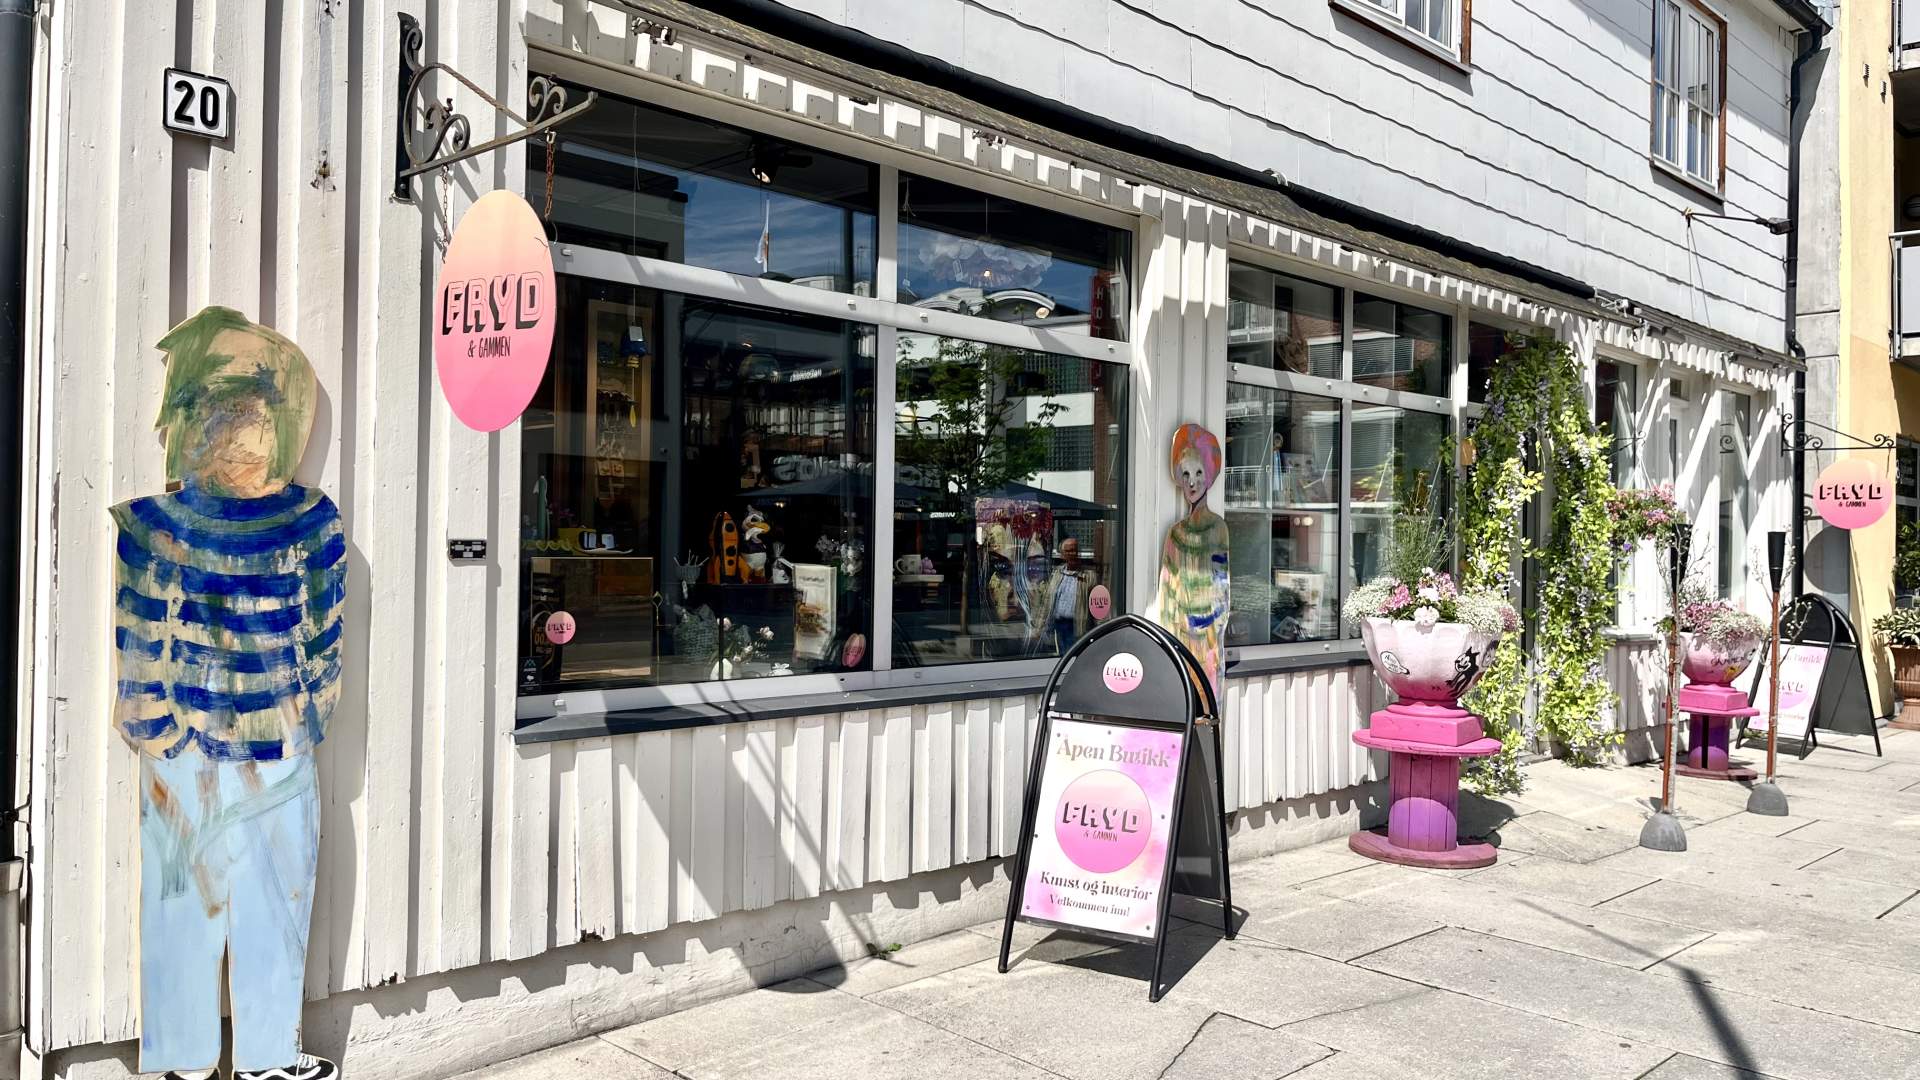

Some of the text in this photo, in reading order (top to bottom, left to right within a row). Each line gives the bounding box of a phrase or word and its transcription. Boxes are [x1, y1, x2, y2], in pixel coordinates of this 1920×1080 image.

[174, 80, 220, 130] 20
[442, 271, 544, 335] FRYD
[468, 336, 512, 358] & GAMMEN
[1819, 483, 1884, 500] FRYD
[1056, 734, 1171, 767] Åpen Butikk
[1062, 800, 1142, 834] FRYD
[1092, 830, 1119, 843] GAMMEN
[1040, 871, 1080, 889] Kunst
[1082, 880, 1099, 897] og
[1049, 893, 1131, 918] Velkommen inn!
